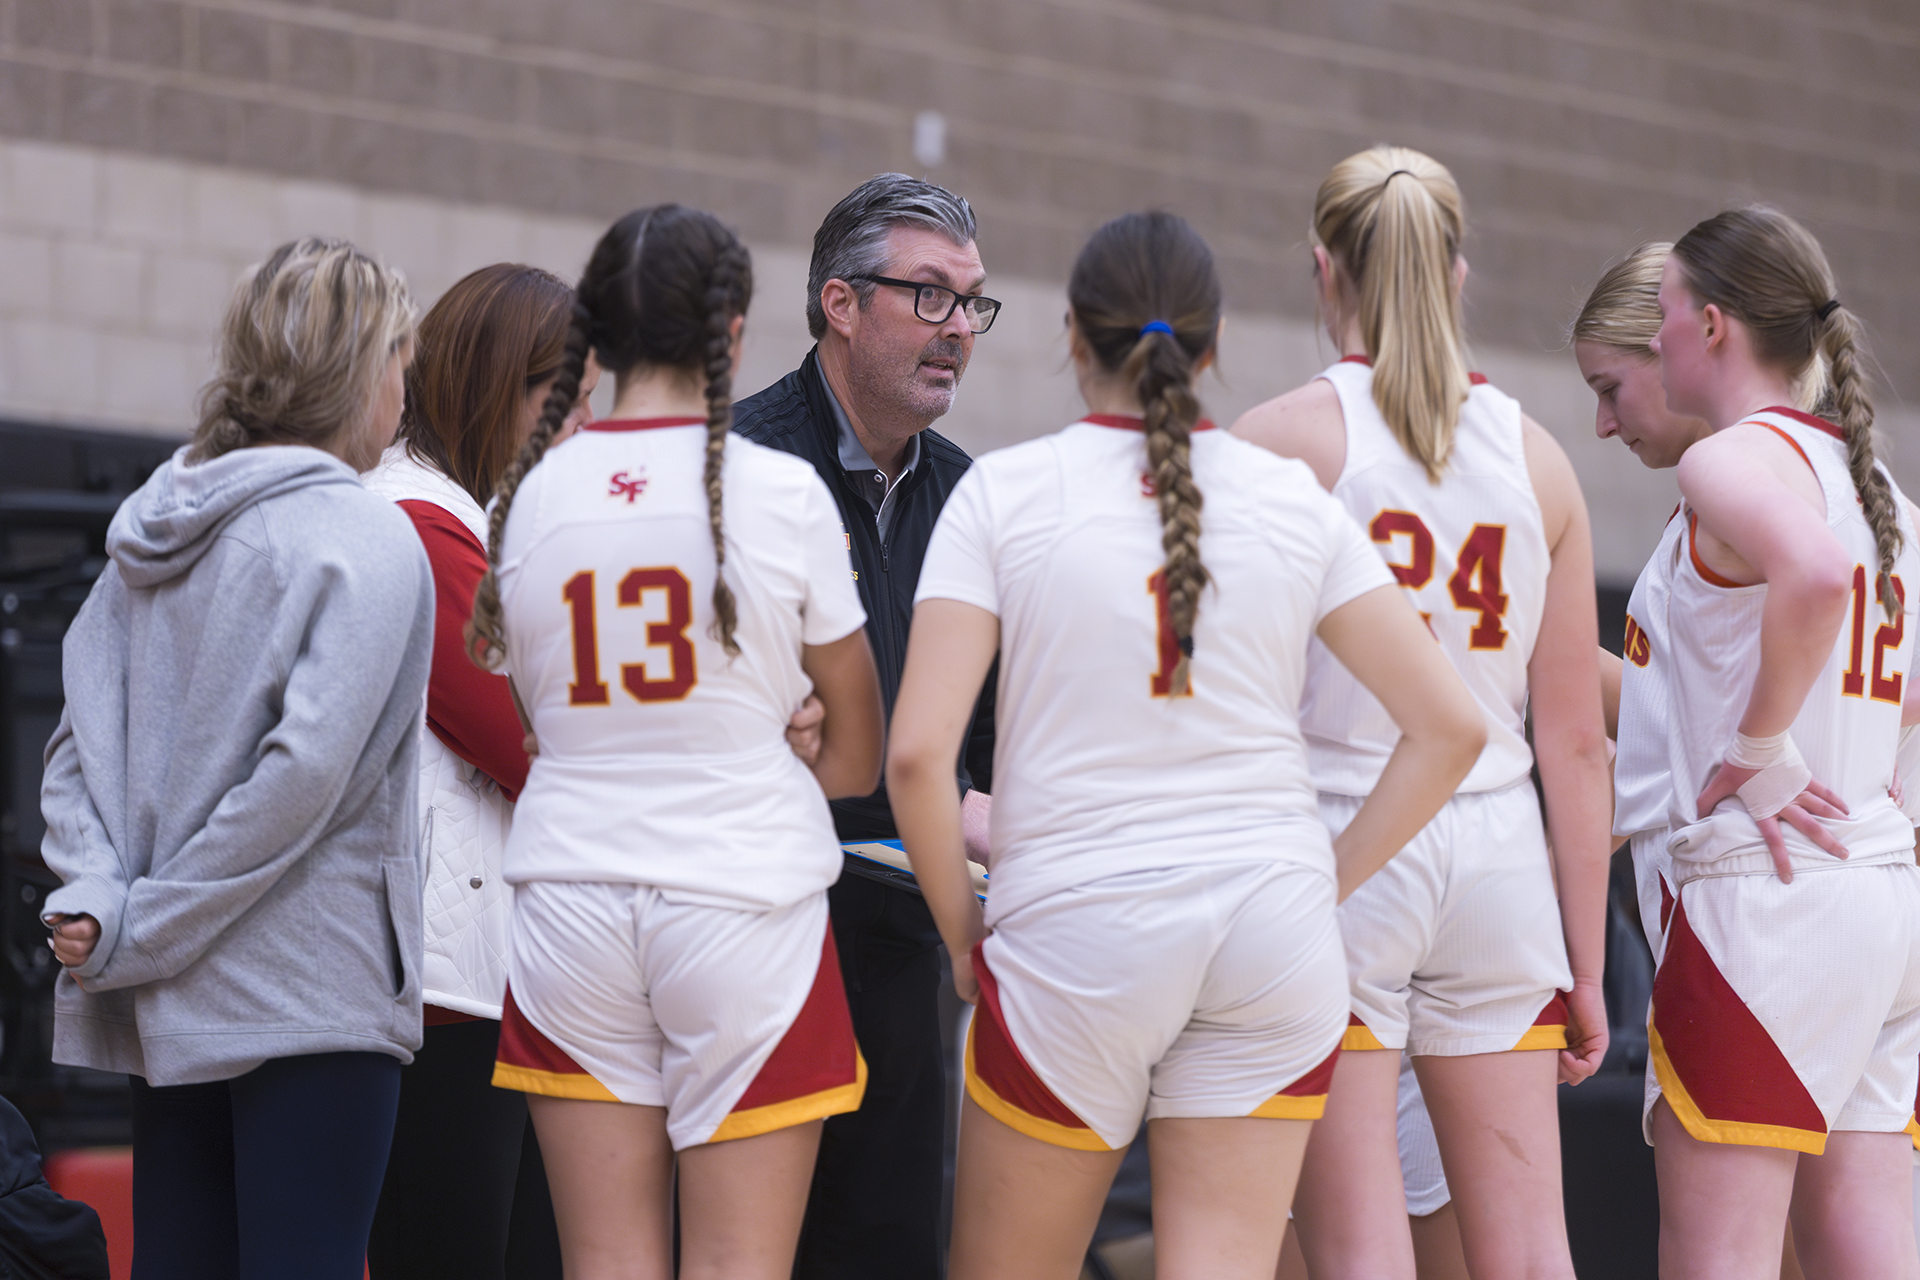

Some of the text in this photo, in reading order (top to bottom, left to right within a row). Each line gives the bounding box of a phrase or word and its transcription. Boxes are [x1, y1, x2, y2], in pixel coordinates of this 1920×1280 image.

[608, 471, 648, 504] SF
[562, 565, 698, 708] 13
[1147, 566, 1194, 698] 1
[1369, 508, 1509, 652] 24
[1841, 562, 1905, 706] 12
